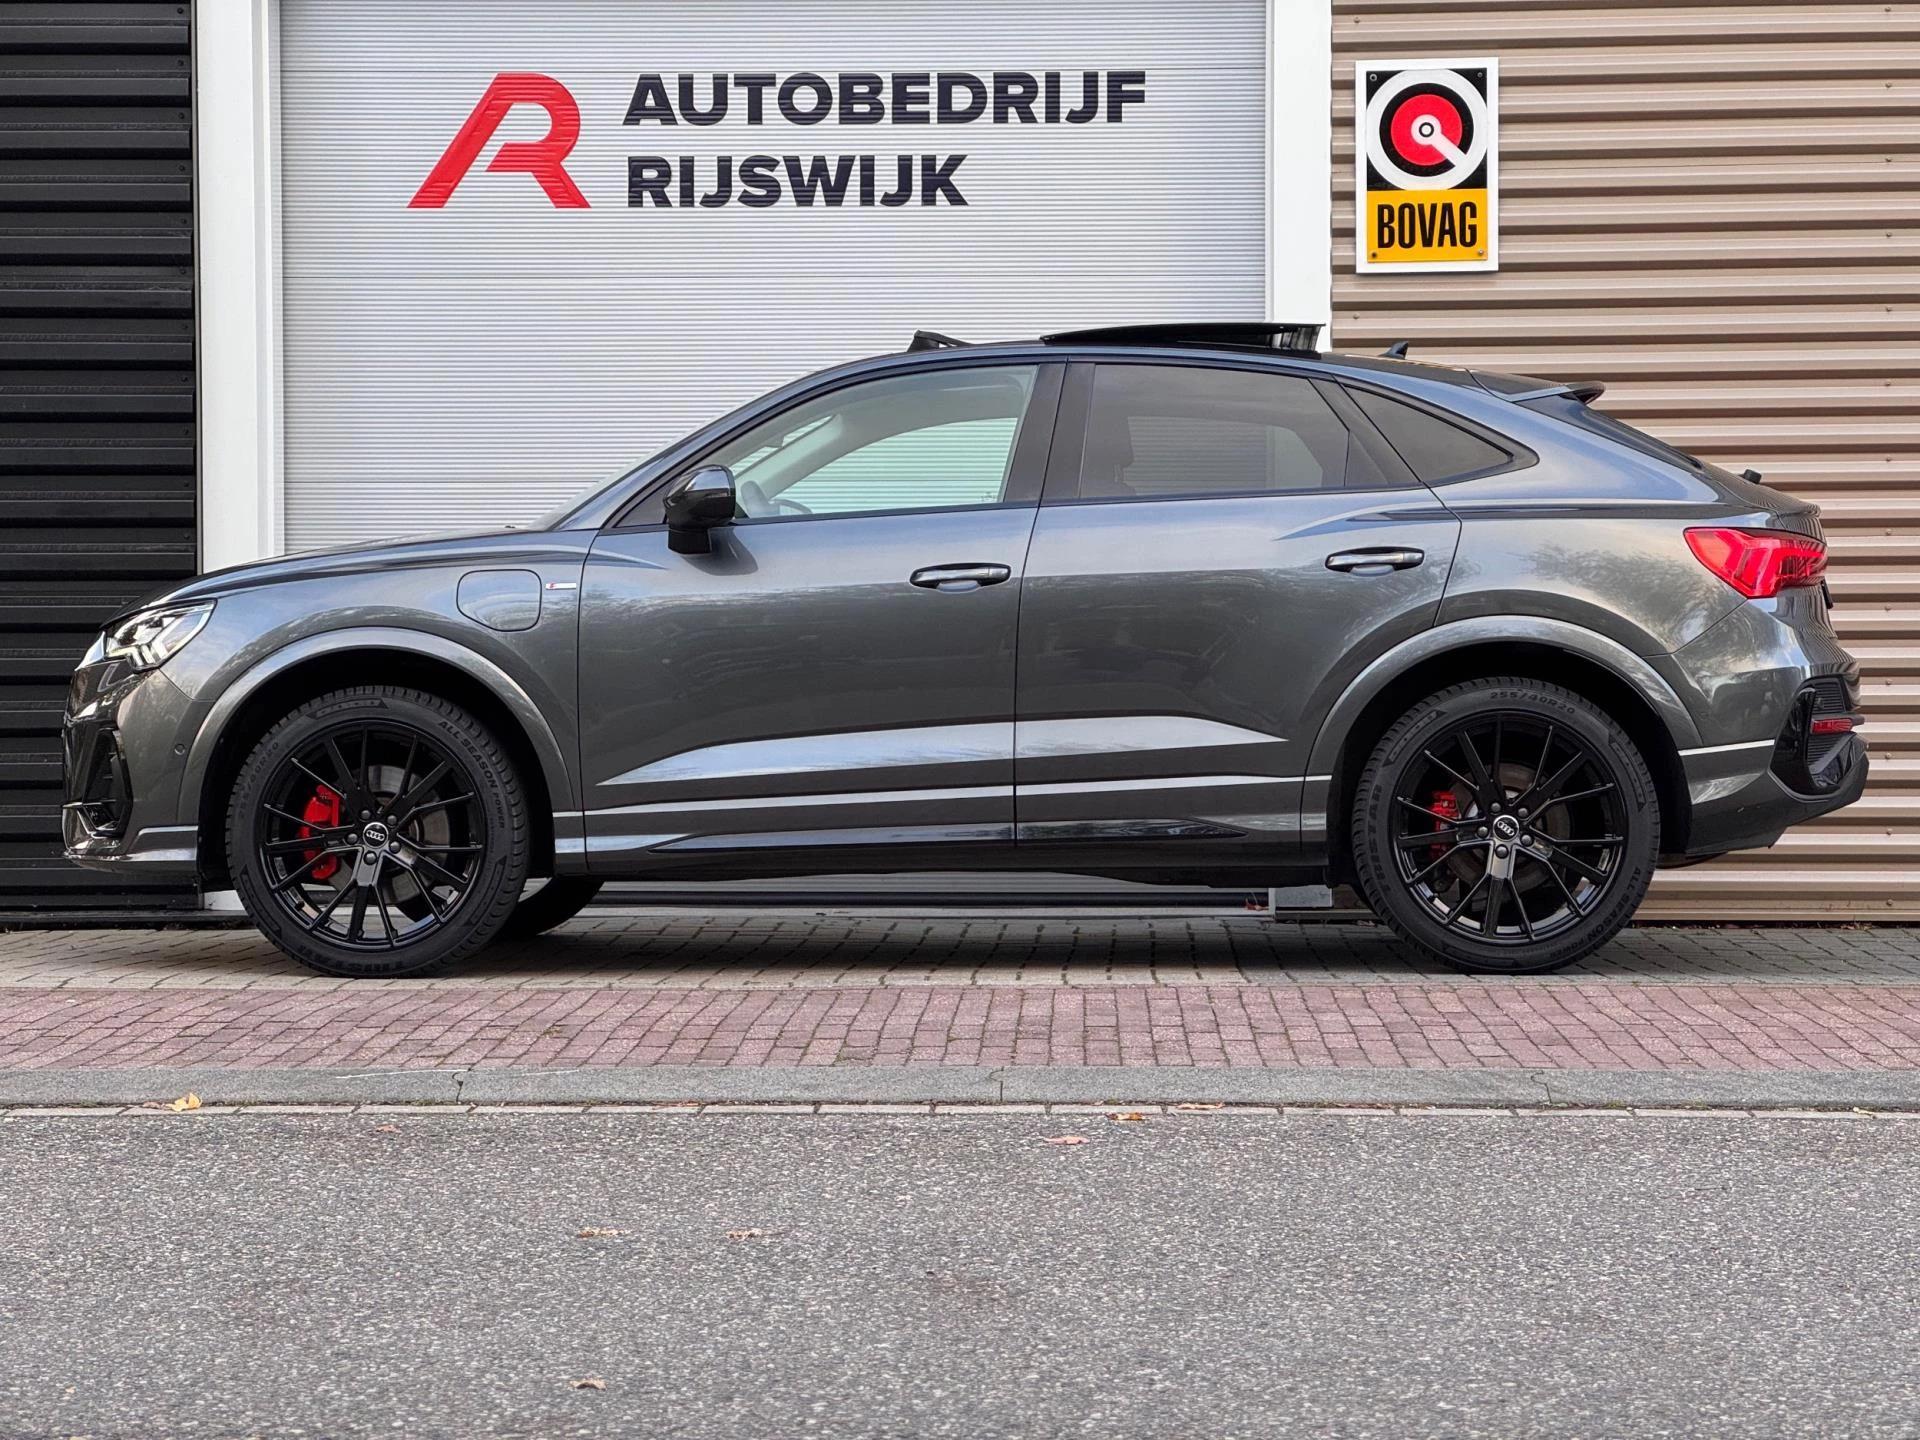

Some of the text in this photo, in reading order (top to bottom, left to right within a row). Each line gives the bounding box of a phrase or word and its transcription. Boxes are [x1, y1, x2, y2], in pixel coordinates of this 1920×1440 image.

[623, 71, 1146, 125] AUTOBEDRIJF
[627, 155, 970, 208] RIJSWIJK
[1377, 201, 1477, 249] BOVAG
[438, 720, 461, 739] ALL
[460, 738, 498, 788] SEASON
